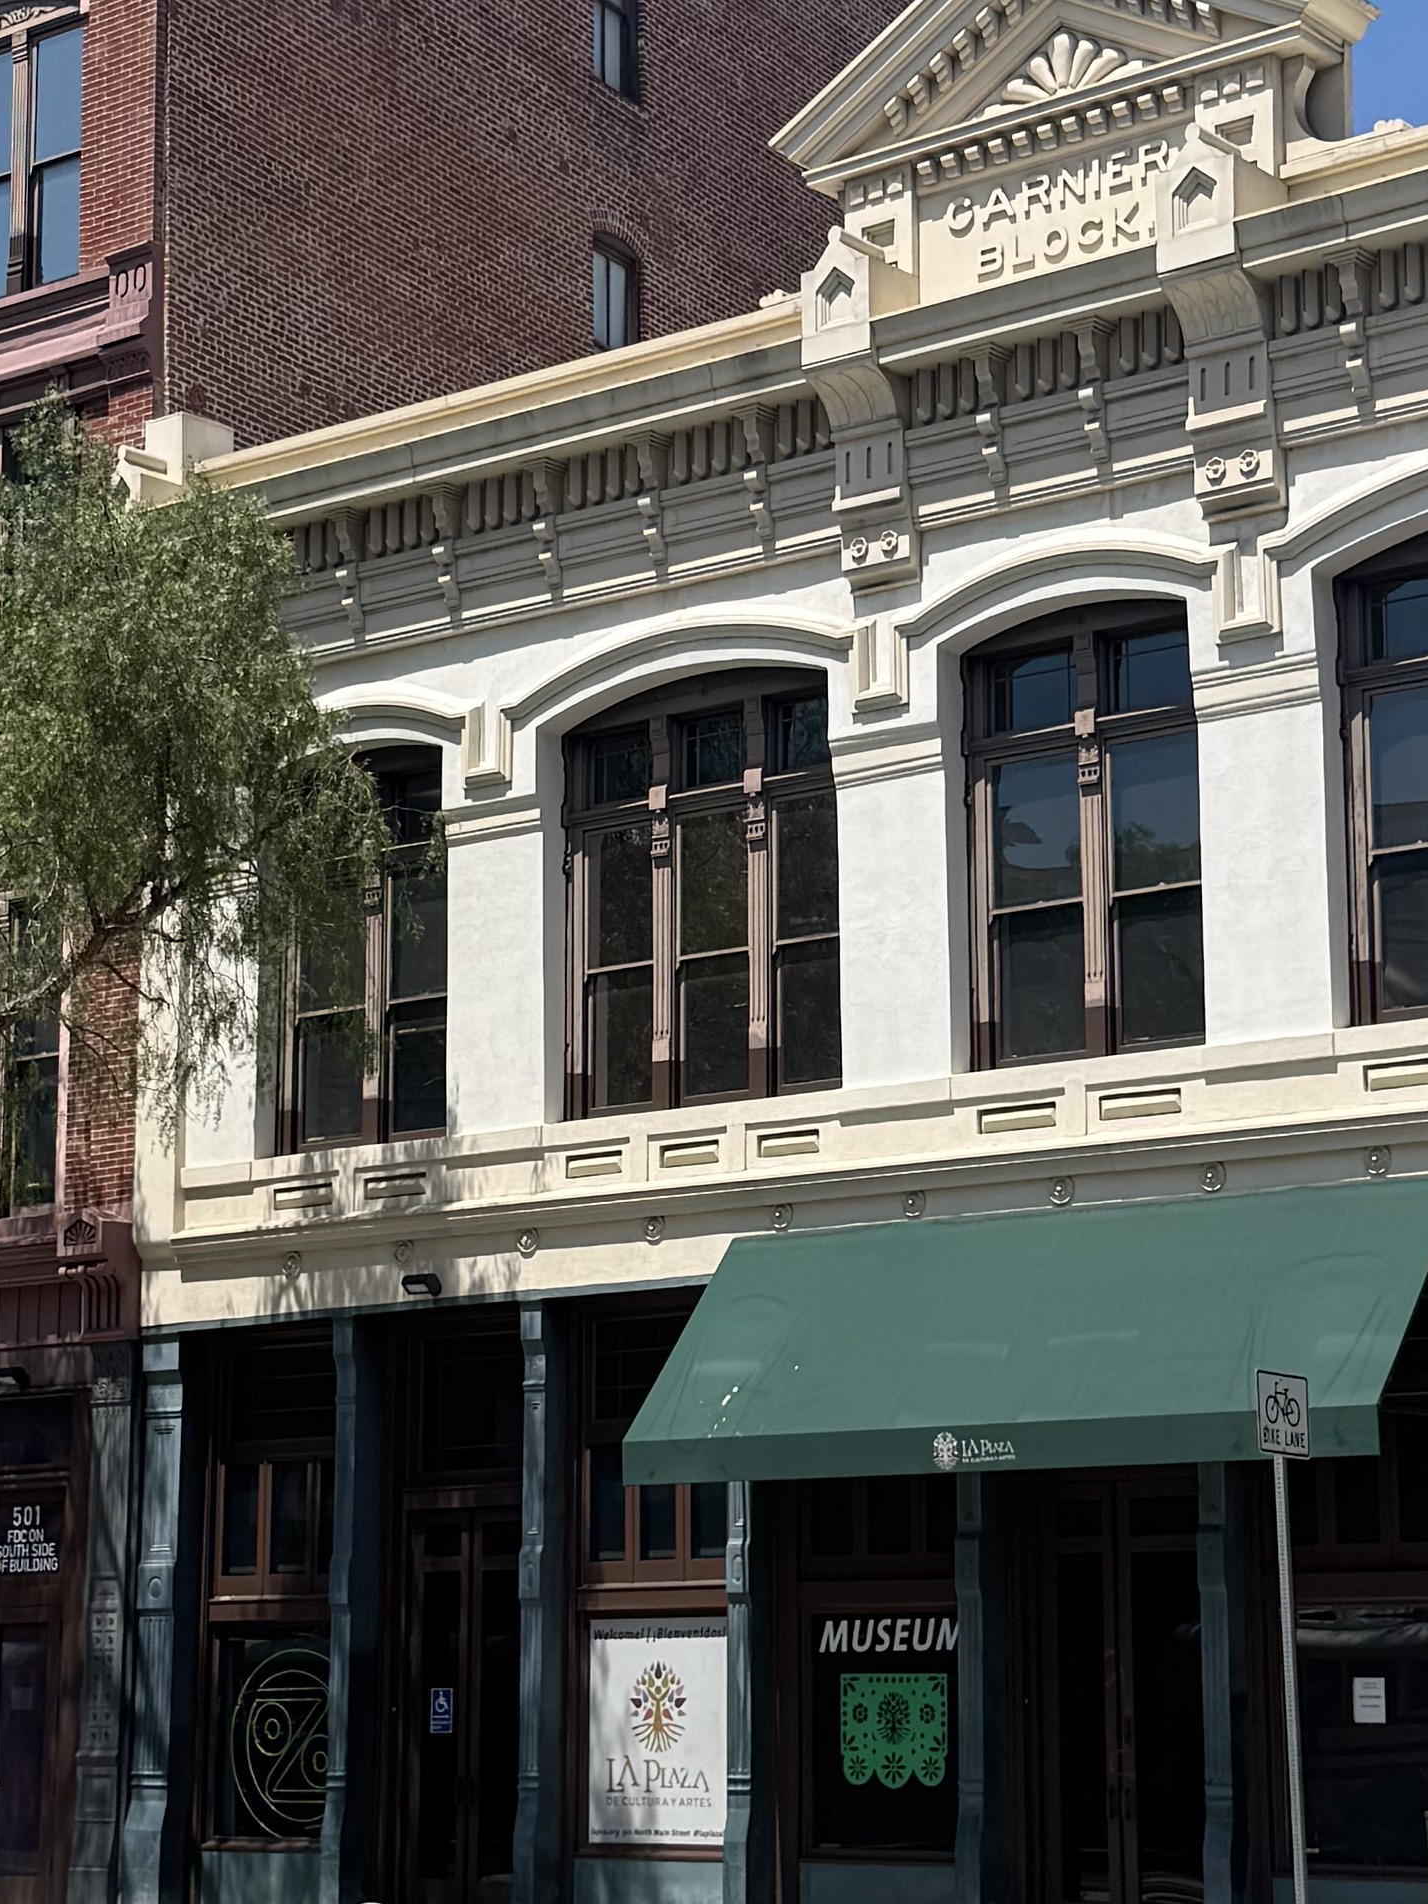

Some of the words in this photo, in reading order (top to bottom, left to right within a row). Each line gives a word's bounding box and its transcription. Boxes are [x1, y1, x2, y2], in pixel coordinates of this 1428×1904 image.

[948, 139, 1170, 234] GARNIER
[1263, 1425, 1280, 1446] BIKE
[1285, 1430, 1306, 1449] LANE
[961, 1439, 979, 1457] LA
[980, 1439, 1014, 1457] PLAZA
[12, 1504, 41, 1527] 501
[7, 1529, 27, 1544] FDC
[28, 1528, 44, 1543] ON
[31, 1542, 56, 1557] SIDE
[9, 1557, 58, 1573] BUILDING
[819, 1618, 959, 1653] MUSEUM
[605, 1754, 640, 1793] LA
[642, 1759, 710, 1793] PLAZA
[606, 1797, 621, 1807] DE
[621, 1796, 668, 1808] CULTURA
[669, 1797, 678, 1807] Y
[678, 1797, 713, 1808] ARTES
